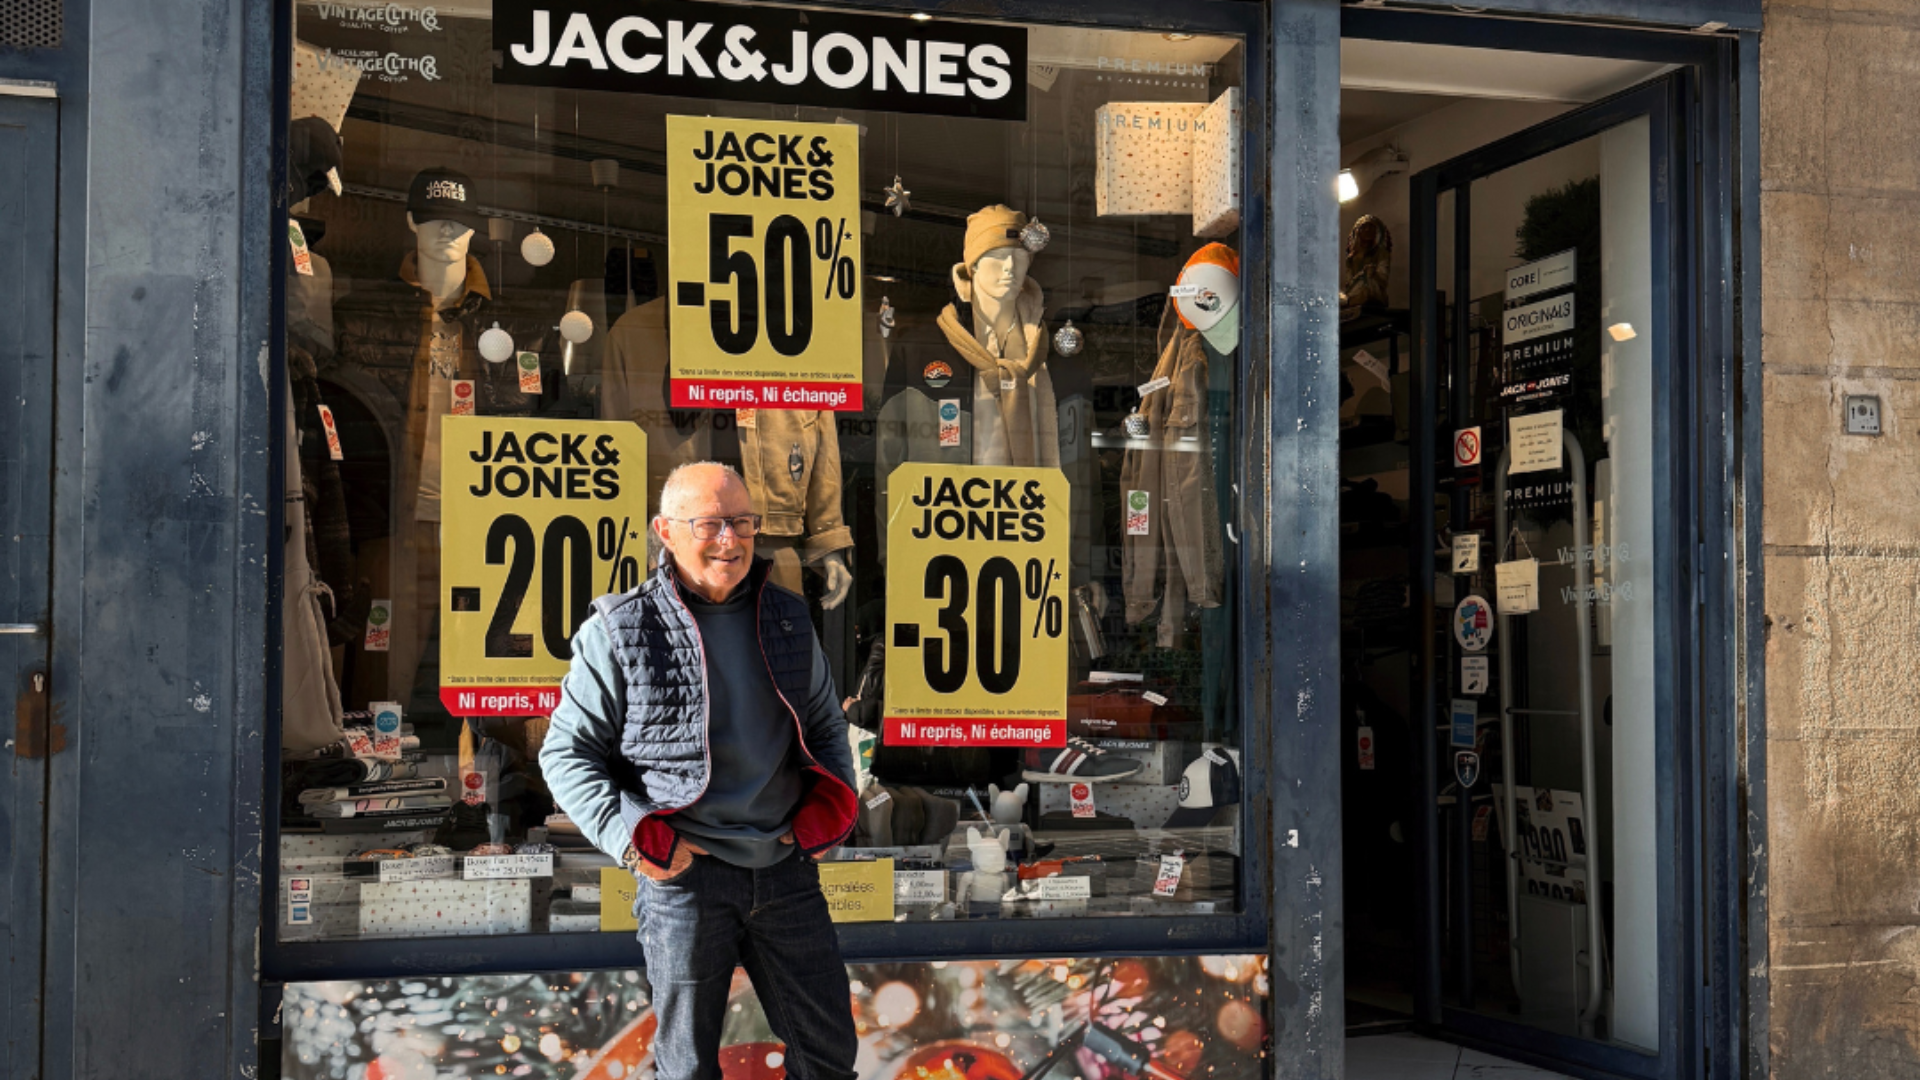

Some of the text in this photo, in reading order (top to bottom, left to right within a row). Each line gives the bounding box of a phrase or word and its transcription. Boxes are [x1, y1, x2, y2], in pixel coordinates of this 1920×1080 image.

[510, 10, 1012, 100] JACK&JONES
[1098, 56, 1206, 77] PREMIUM
[1098, 112, 1206, 133] PREMIUM
[693, 130, 834, 168] JACK&
[693, 163, 834, 201] JONES
[426, 189, 466, 202] JONES
[1510, 273, 1536, 289] CORE
[1507, 302, 1571, 331] ORIGINALS
[1503, 337, 1574, 363] PREMIUM
[1535, 373, 1571, 391] JONES
[688, 385, 848, 407] Ni repris, Ni échangé
[469, 430, 621, 467] JACK&
[469, 465, 621, 500] JONES
[912, 477, 1046, 511] JACK&
[1503, 480, 1576, 502] PREMIUM
[912, 509, 1046, 543] JONES
[458, 692, 556, 712] Ni repris, Ni
[900, 723, 1052, 743] Ni repris, Ni échangé
